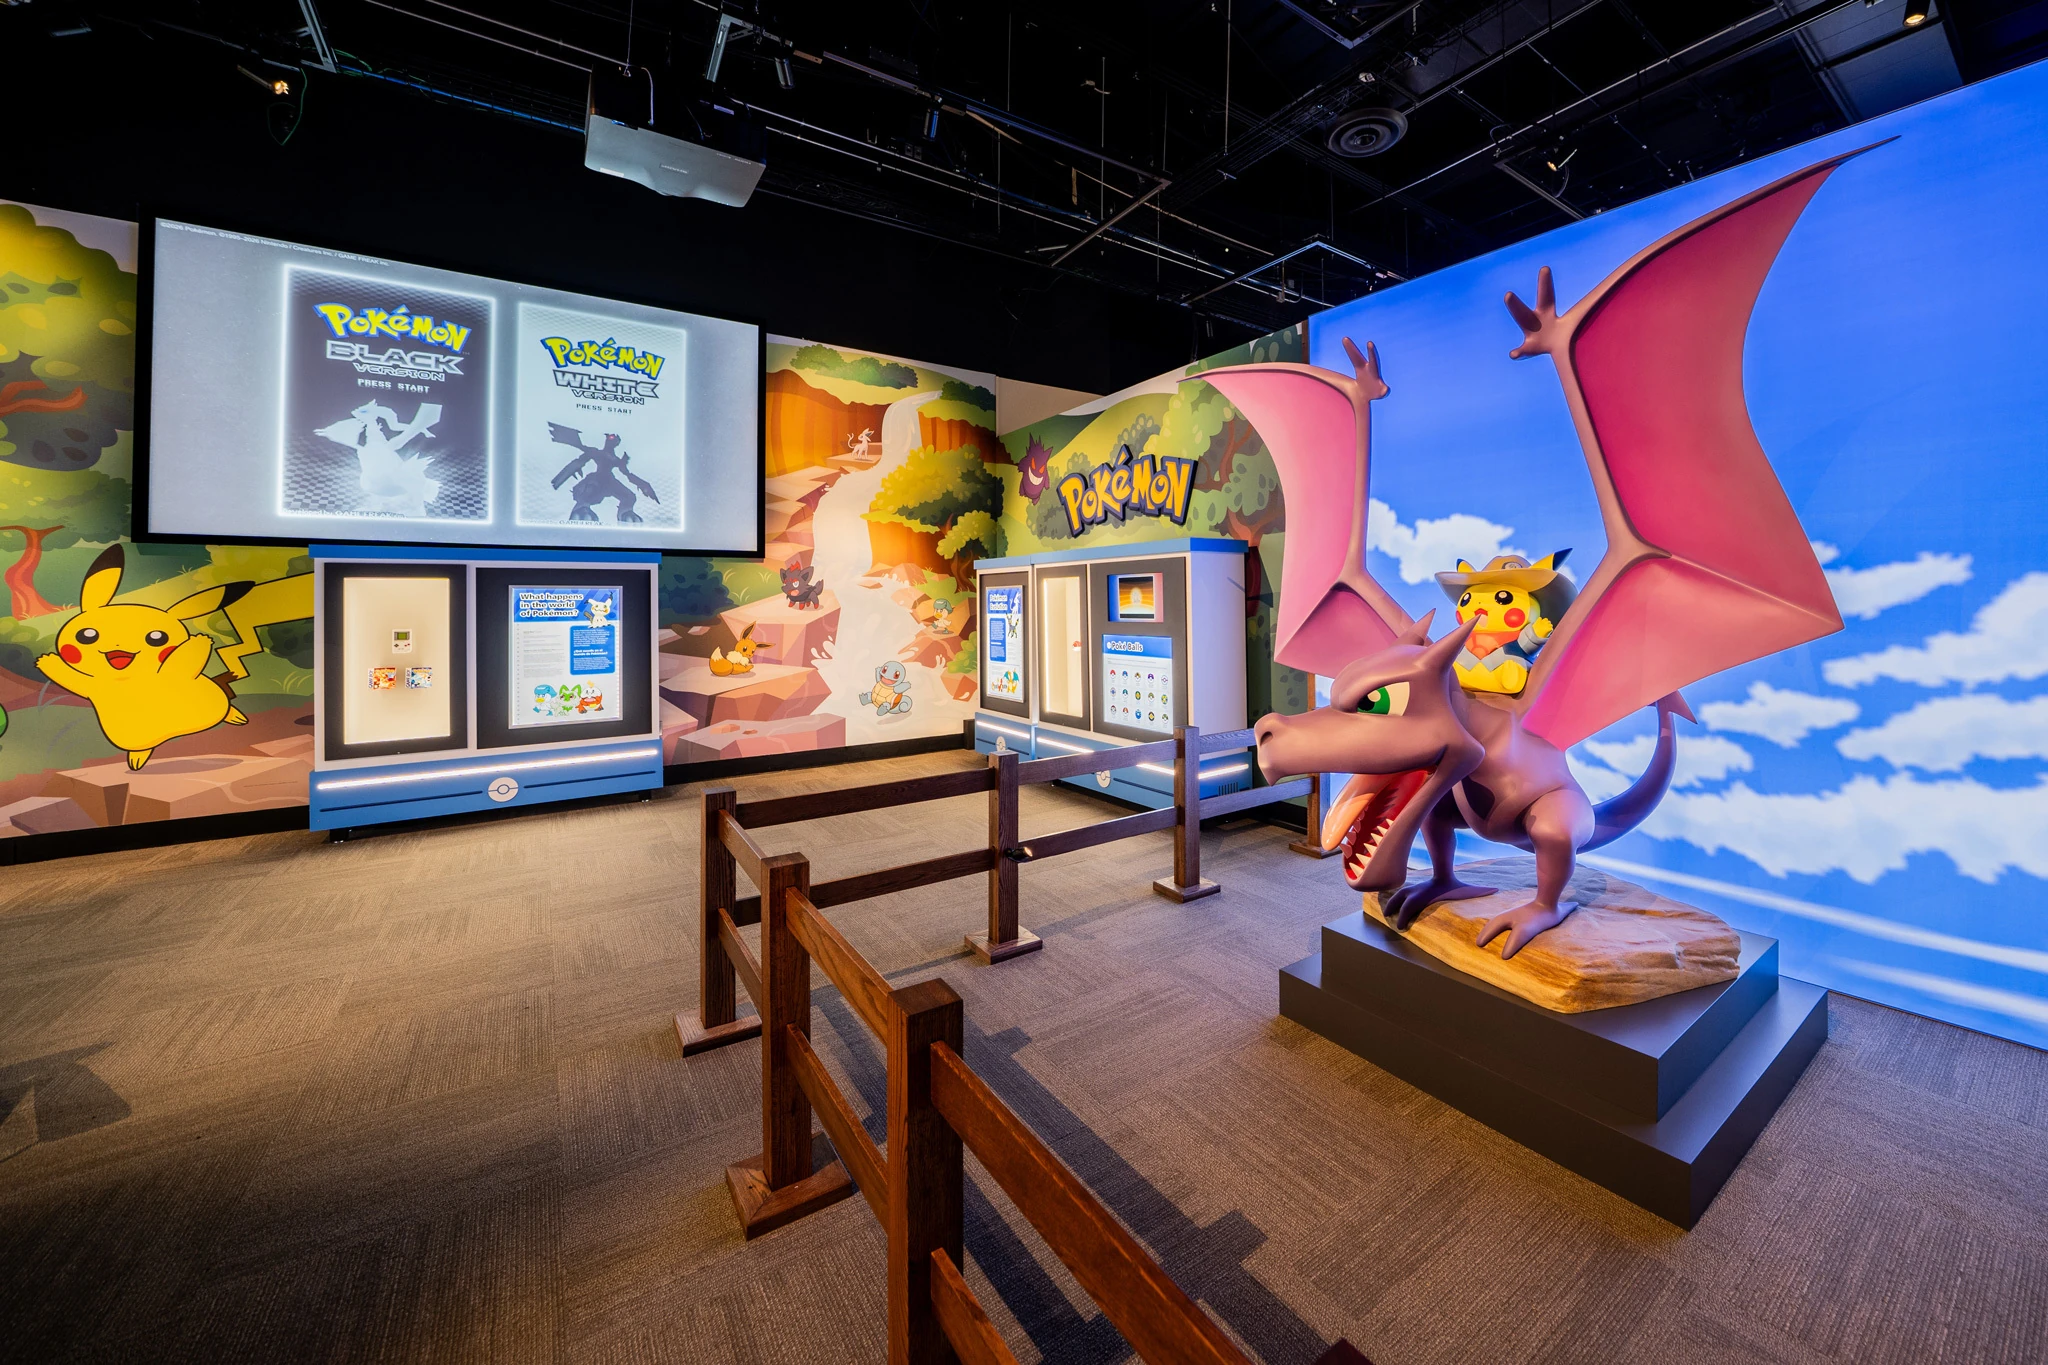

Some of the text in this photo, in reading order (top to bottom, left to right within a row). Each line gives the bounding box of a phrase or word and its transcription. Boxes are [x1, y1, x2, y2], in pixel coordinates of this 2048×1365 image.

[184, 225, 218, 237] Pokémon.
[261, 239, 289, 249] Nintendo
[293, 245, 322, 255] Creatures
[338, 253, 357, 261] GAME
[358, 256, 380, 265] FREAK
[326, 339, 465, 375] BLACK
[353, 362, 445, 382] VERSION
[357, 378, 430, 394] PRESS START
[552, 369, 660, 399] WHITE
[571, 389, 645, 405] VERSION
[576, 403, 632, 415] PRESS START
[546, 593, 583, 601] happens
[520, 609, 578, 617] of Pokémon?
[1110, 641, 1143, 652] Poké Balls
